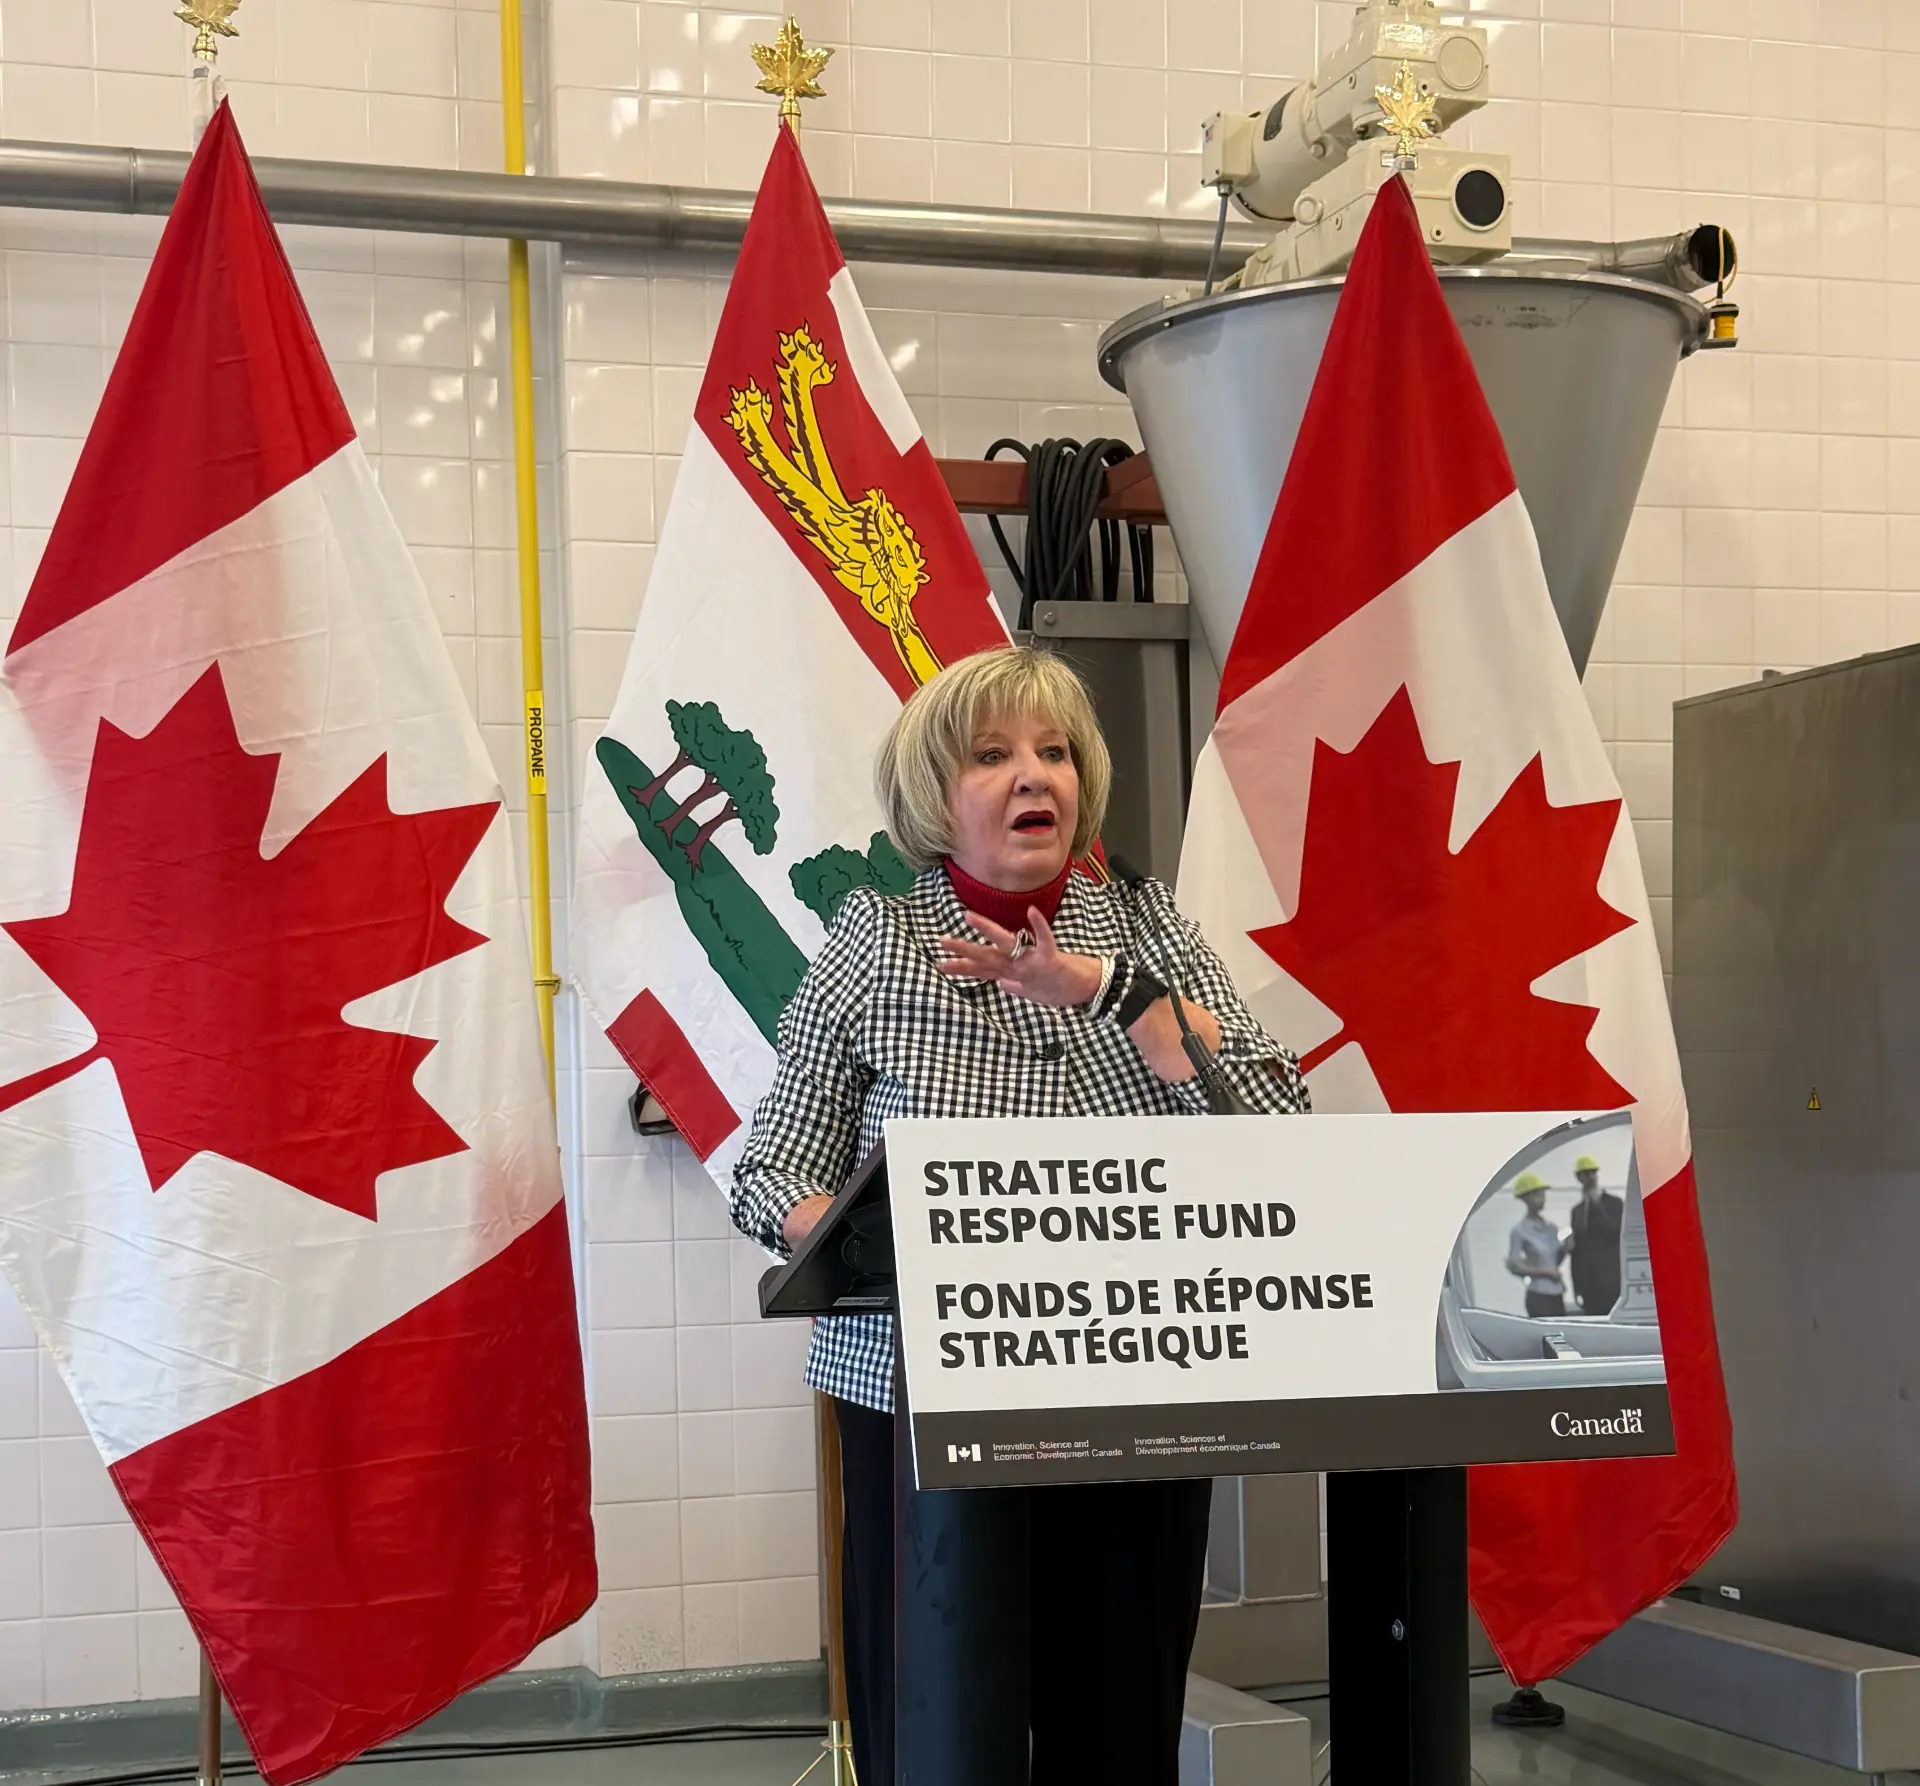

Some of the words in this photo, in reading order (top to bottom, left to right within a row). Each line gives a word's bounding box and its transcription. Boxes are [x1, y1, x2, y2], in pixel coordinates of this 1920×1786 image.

[529, 707, 544, 778] PROPANE
[923, 1158, 1167, 1197] STRATEGIC
[928, 1205, 1161, 1244] RESPONSE
[1174, 1202, 1296, 1240] FUND
[935, 1280, 1092, 1320] FONDS
[1105, 1279, 1161, 1316] DE
[1173, 1267, 1374, 1314] RÉPONSE
[939, 1318, 1249, 1369] STRATÉGIQUE
[1179, 1434, 1217, 1444] Sciences
[1217, 1434, 1226, 1443] et
[1550, 1408, 1645, 1437] Canada
[993, 1452, 1035, 1462] Economic
[1036, 1451, 1090, 1461] Development
[1091, 1448, 1123, 1458] Canada
[1039, 1440, 1073, 1450] Science
[1073, 1440, 1090, 1449] and
[1199, 1443, 1249, 1453] économique
[1249, 1441, 1281, 1451] Canada
